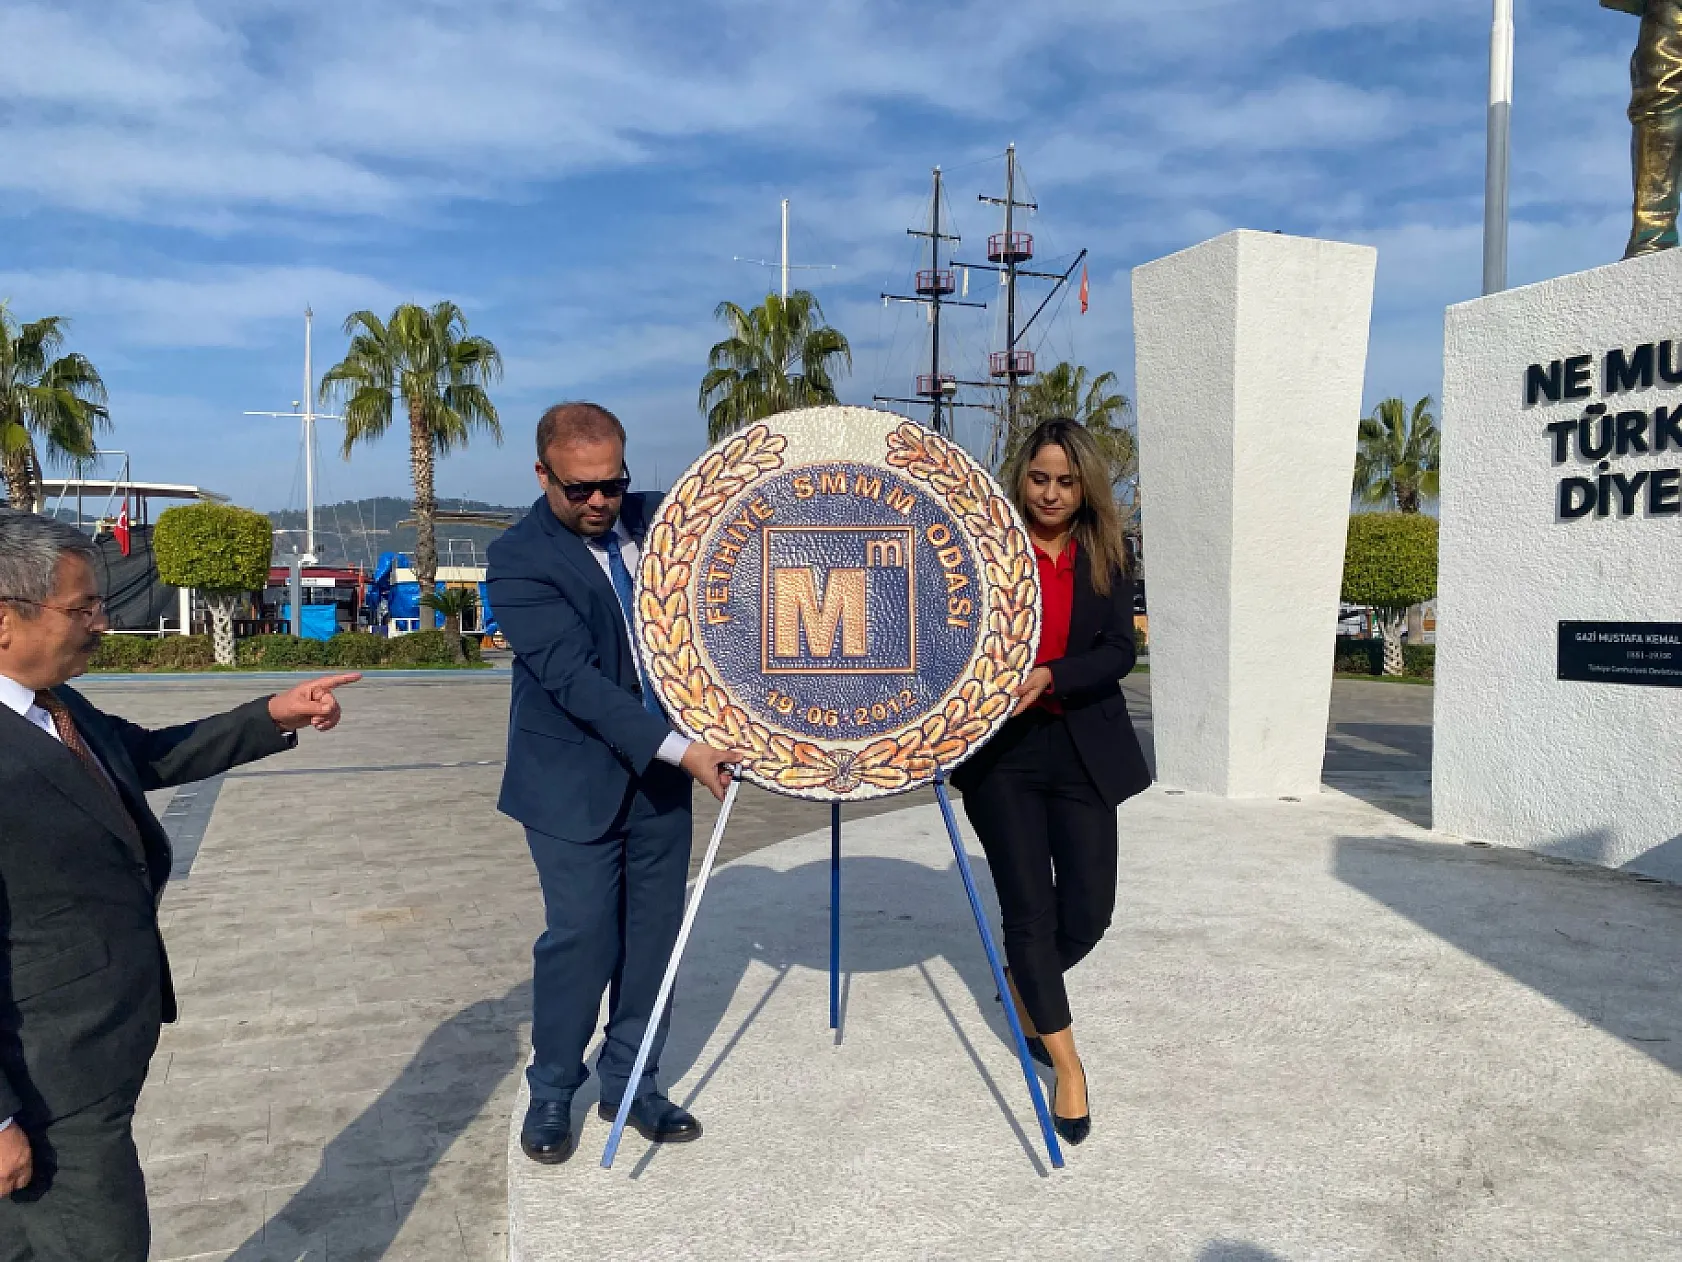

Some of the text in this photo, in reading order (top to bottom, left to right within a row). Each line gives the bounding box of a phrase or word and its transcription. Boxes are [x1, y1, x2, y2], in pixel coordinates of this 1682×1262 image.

[1526, 355, 1592, 404] NE
[1546, 402, 1682, 463] TÜRK
[1559, 461, 1682, 518] DİYE
[791, 471, 917, 516] SMMM
[926, 523, 973, 628] ODASI
[773, 567, 867, 658] M
[1598, 632, 1643, 644] MUSTAFA
